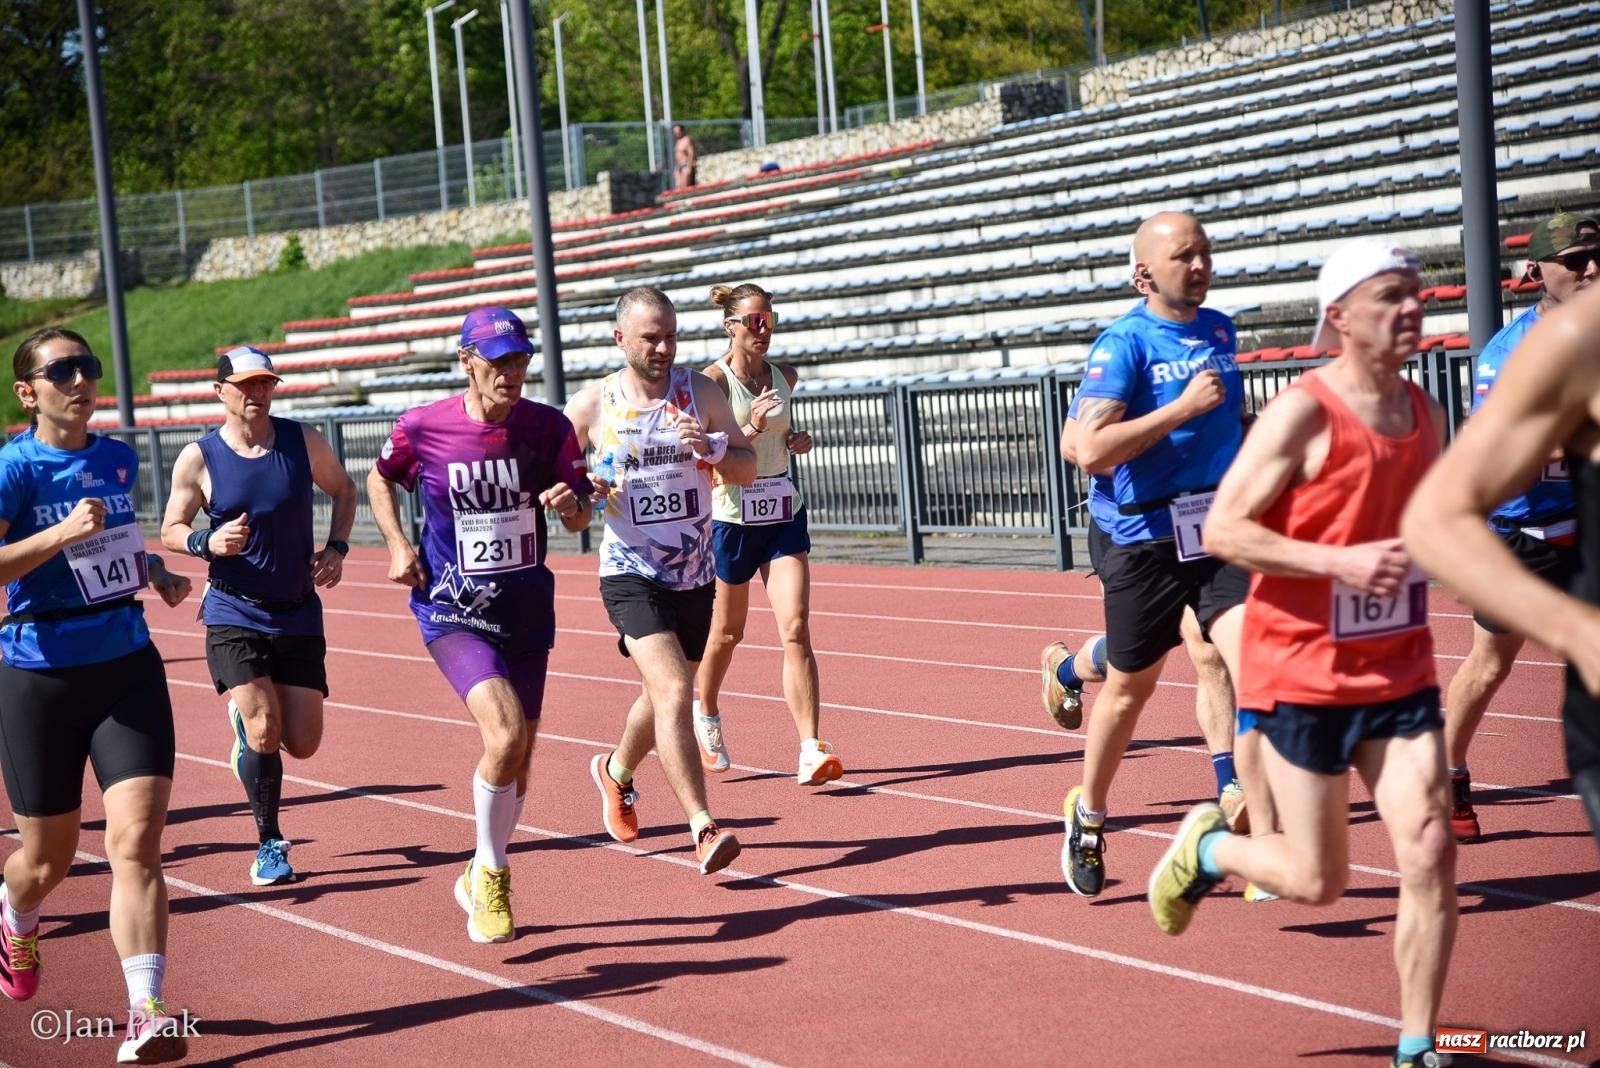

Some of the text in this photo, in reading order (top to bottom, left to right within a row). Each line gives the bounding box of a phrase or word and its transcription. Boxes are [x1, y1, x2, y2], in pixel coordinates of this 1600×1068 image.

[657, 445, 676, 456] BIEG
[447, 458, 521, 510] RUN
[639, 493, 681, 516] 238
[751, 499, 777, 516] 187
[500, 515, 520, 524] GRANIC
[473, 538, 513, 563] 231
[92, 558, 131, 589] 141
[1350, 593, 1398, 624] 167
